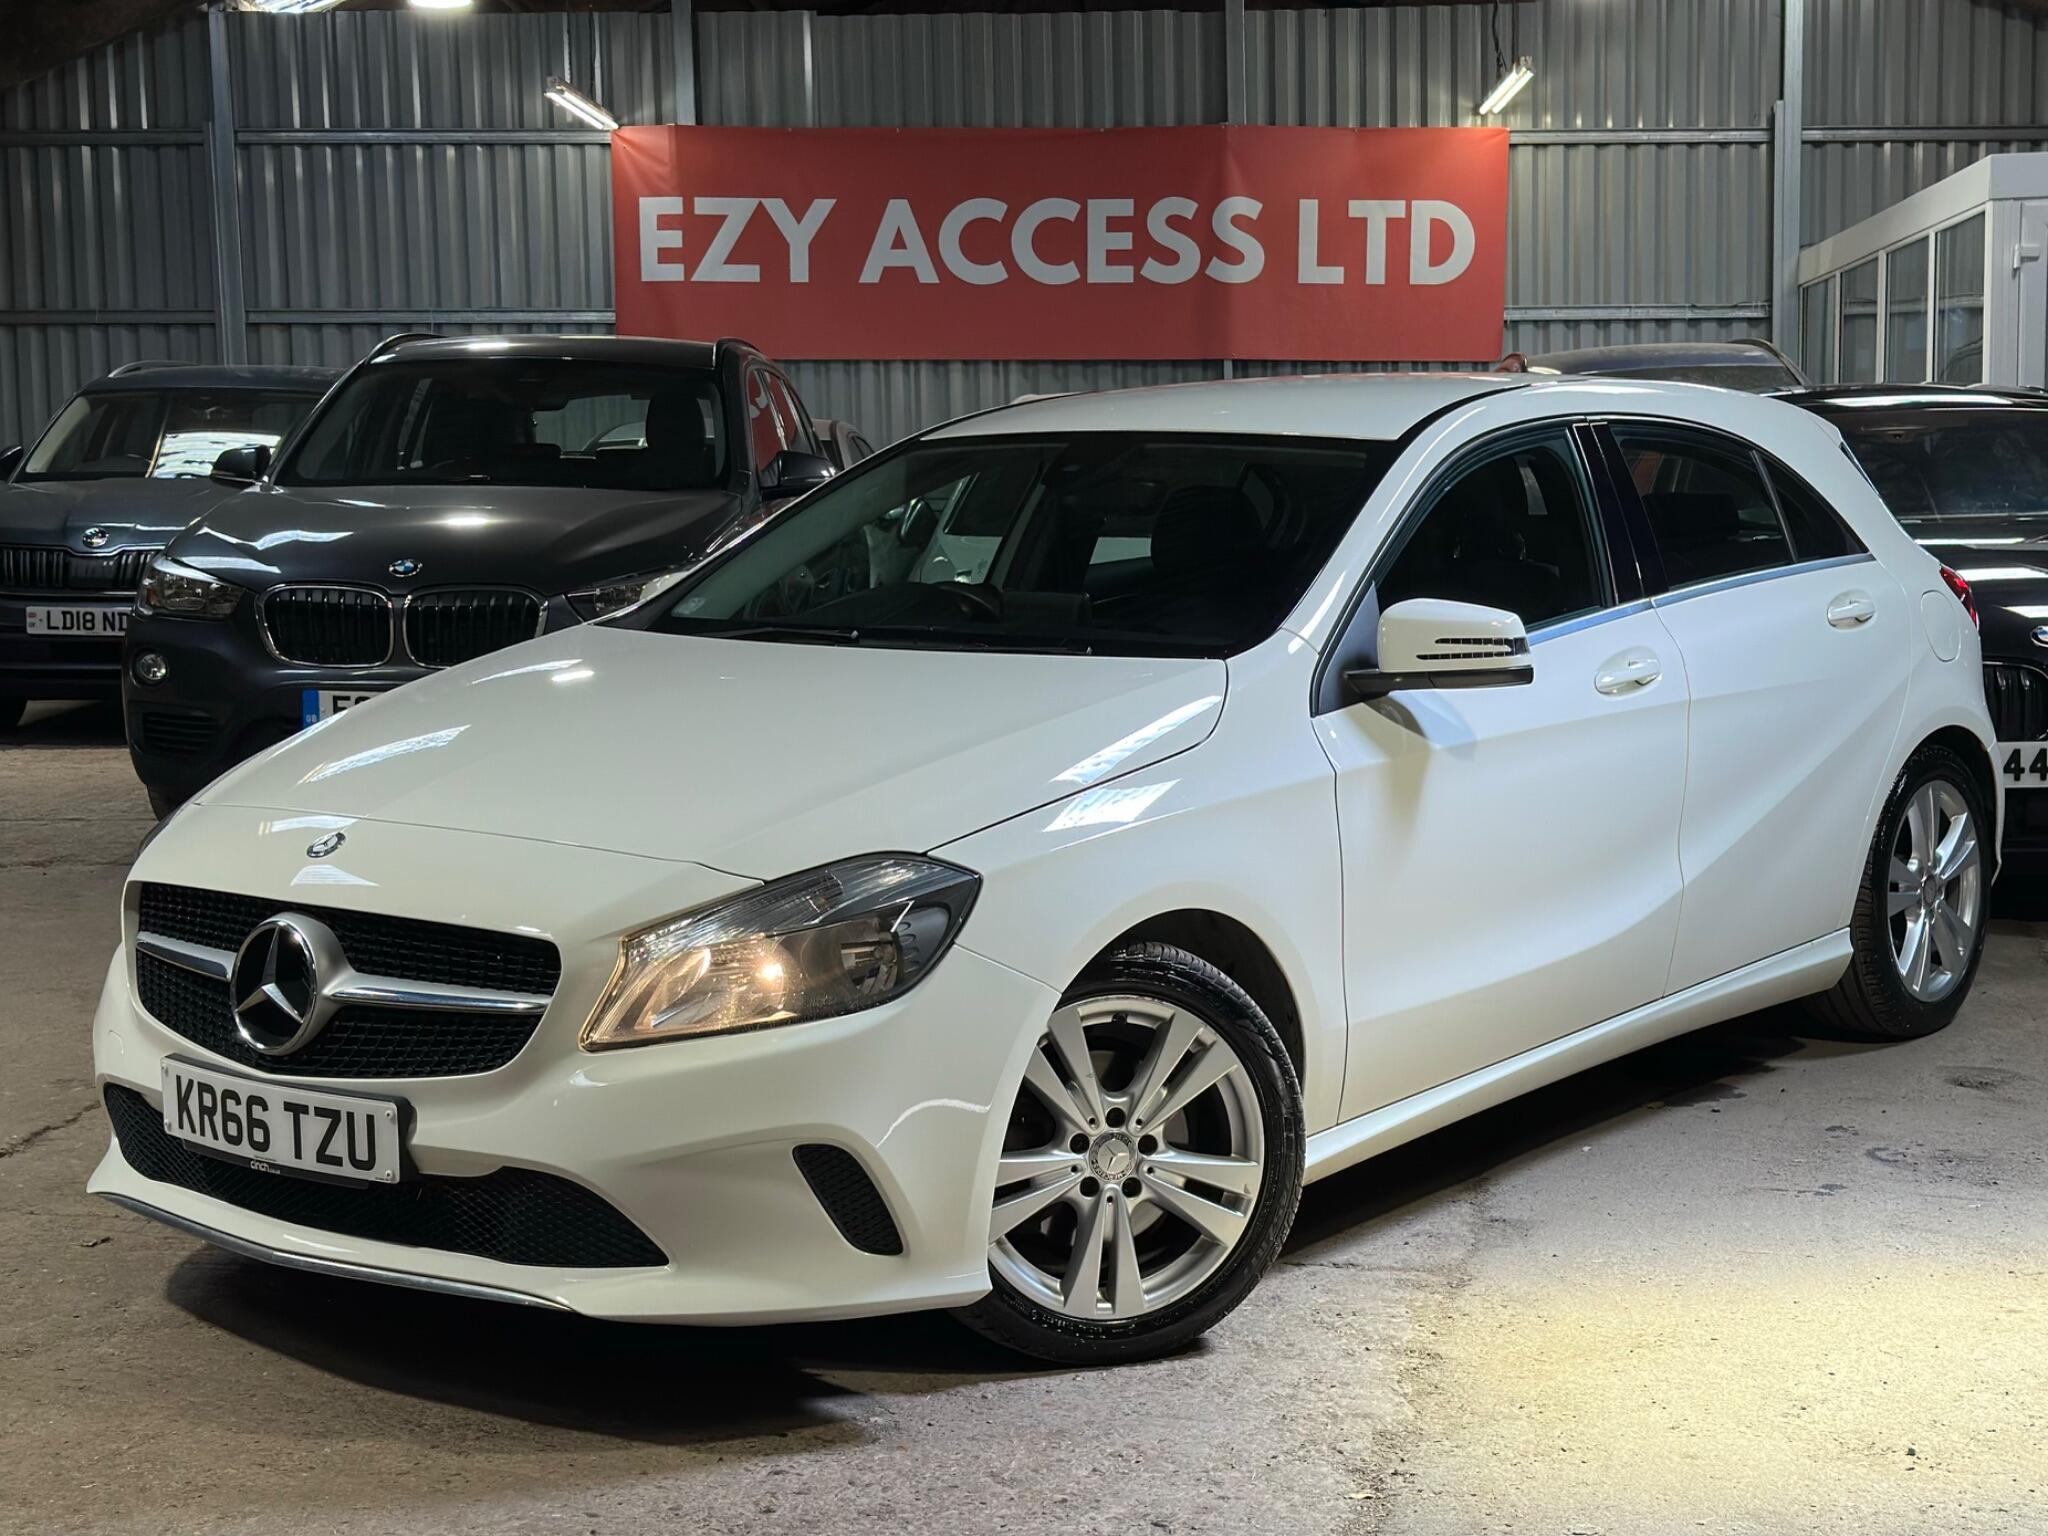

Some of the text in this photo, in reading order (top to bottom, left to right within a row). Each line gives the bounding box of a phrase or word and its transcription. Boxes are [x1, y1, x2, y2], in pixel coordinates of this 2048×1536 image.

[639, 196, 1476, 285] EZY ACCESS LTD
[47, 610, 95, 631] LD18
[2003, 748, 2048, 782] 44
[176, 1075, 377, 1172] KR66 TZU
